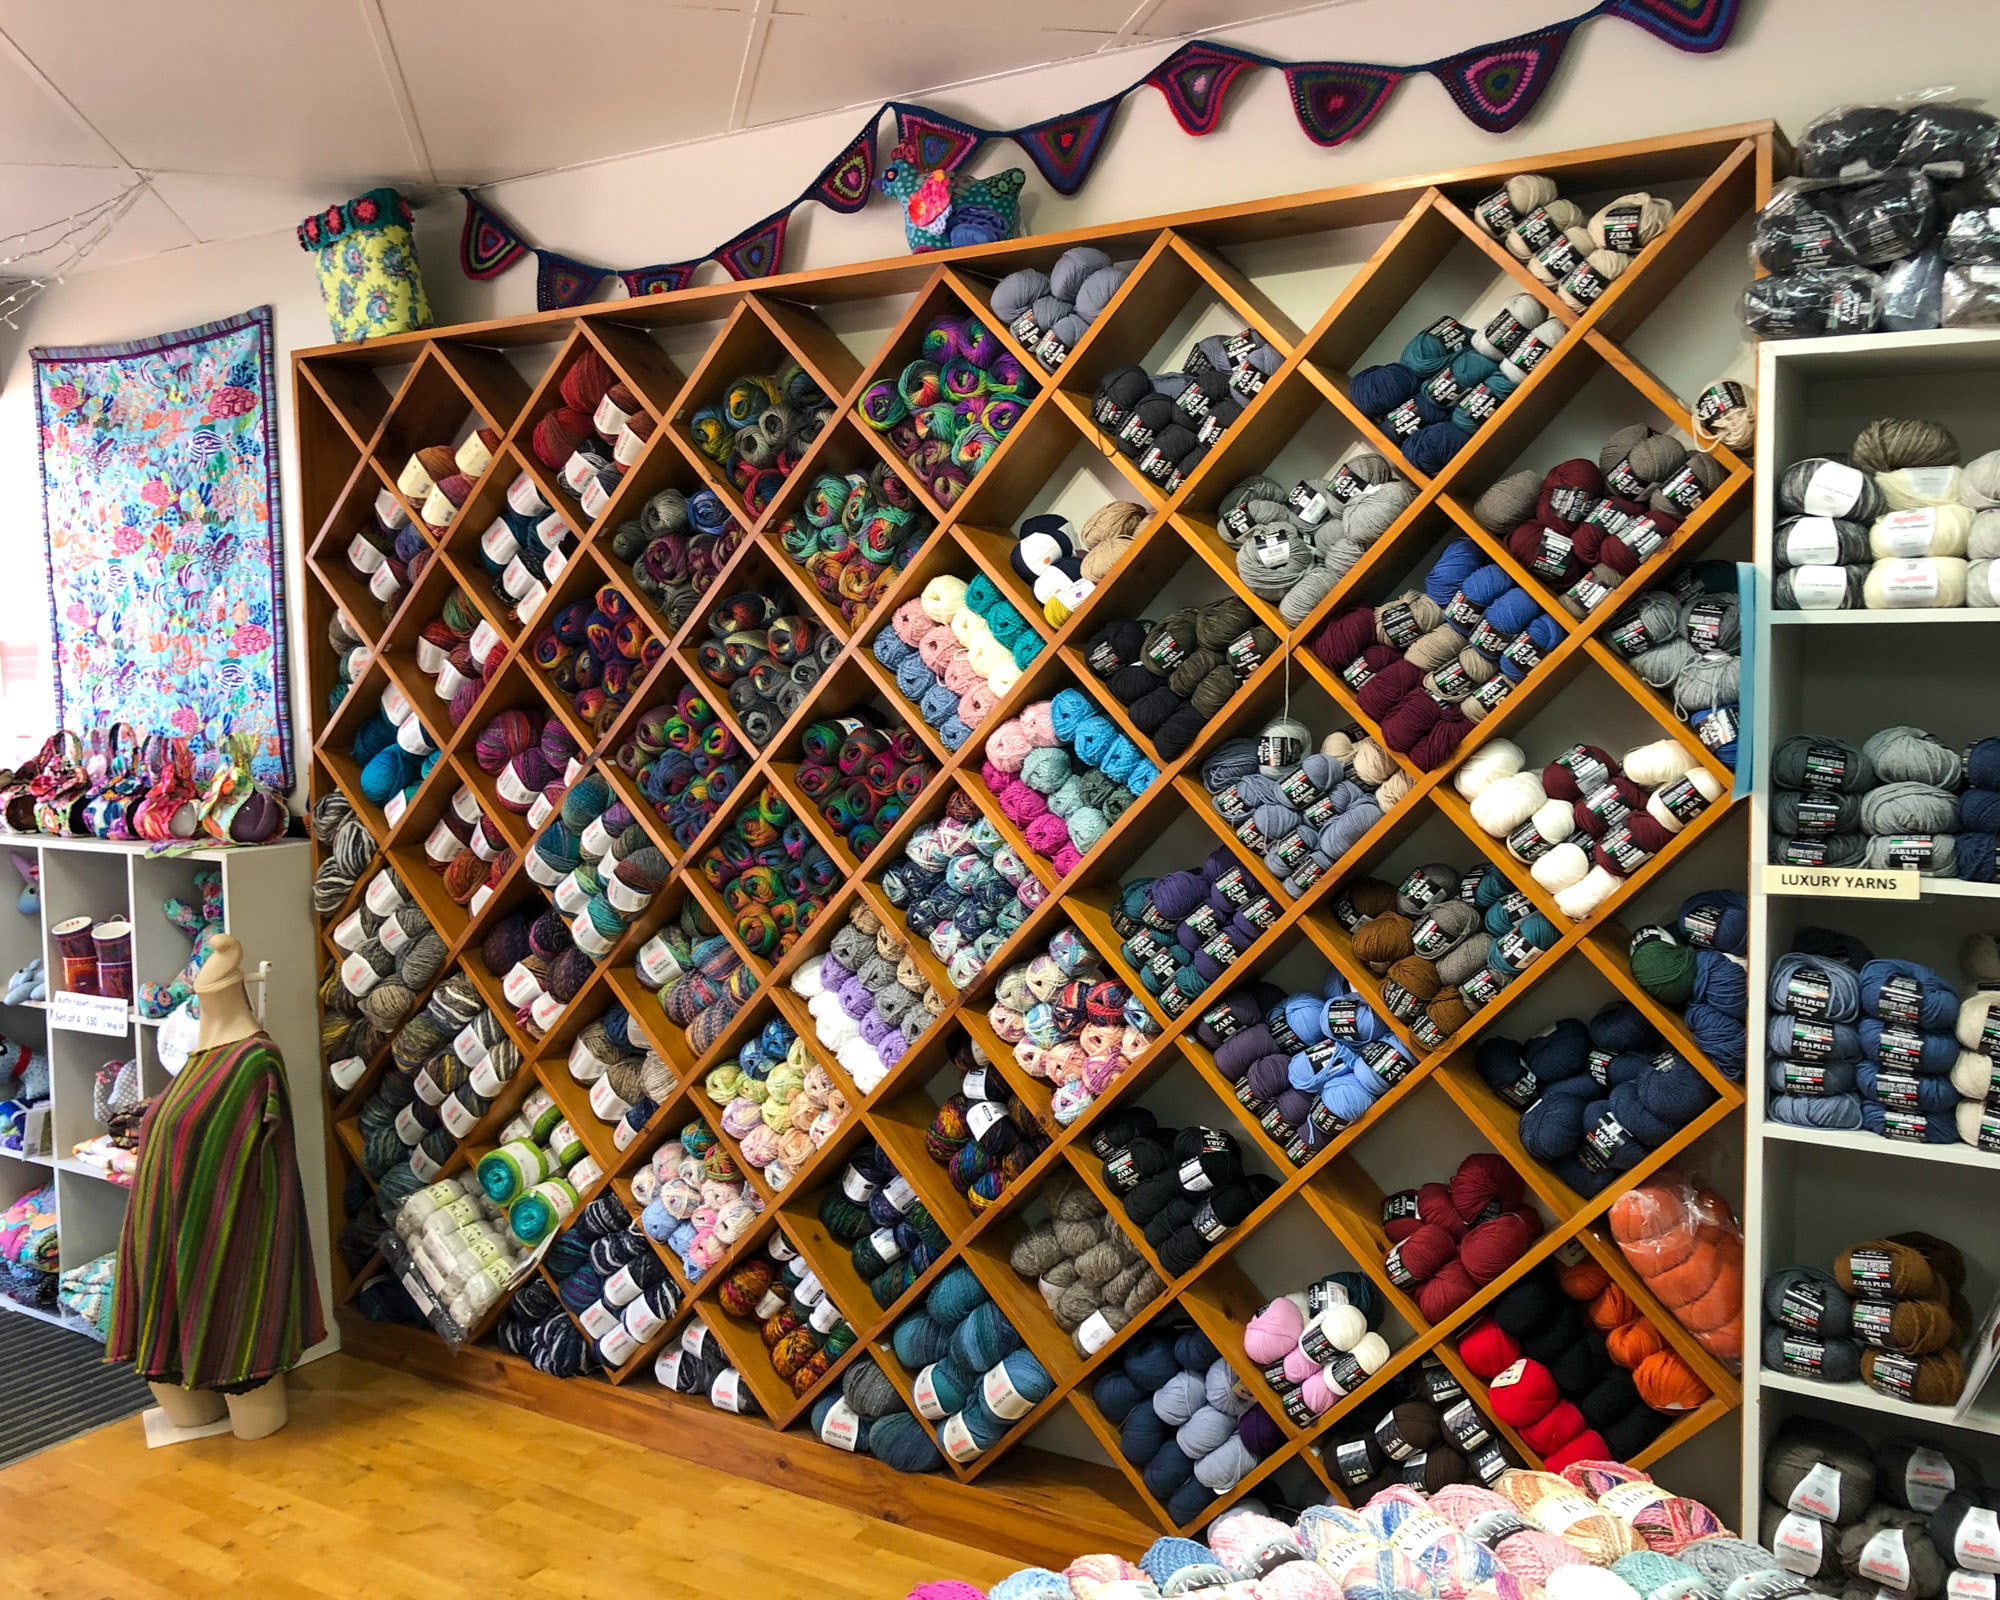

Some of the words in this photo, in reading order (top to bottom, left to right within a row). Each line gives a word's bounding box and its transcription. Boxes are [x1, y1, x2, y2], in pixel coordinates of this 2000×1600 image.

[1622, 635, 1646, 648] ZARA
[1693, 631, 1712, 639] ZARA
[1513, 644, 1532, 661] ZARA
[1353, 671, 1371, 686] ZARA
[1444, 675, 1465, 690] ZARA
[1482, 681, 1501, 699] ZARA
[1805, 773, 1823, 781] ZARA
[1824, 775, 1842, 783] PLUS
[1291, 784, 1309, 798] ZARA
[1676, 797, 1701, 817] ZARA
[1524, 843, 1548, 861] ZARA
[1782, 874, 1840, 887] LUXURY
[1846, 877, 1897, 889] YARNS
[1226, 883, 1245, 897] ZARA
[1197, 917, 1214, 933] ZARA
[1255, 911, 1273, 925] ZARA
[1425, 933, 1441, 950] ZARA
[1215, 943, 1232, 958] ZARA
[1475, 984, 1493, 1000] ZARA
[1788, 995, 1807, 1004] ZARA
[1807, 999, 1826, 1008] PLUS
[54, 1012, 66, 1022] Set
[68, 1014, 75, 1022] of
[1214, 1015, 1235, 1032] ZARA
[1333, 1025, 1355, 1034] ZARA
[1793, 1040, 1813, 1049] ZARA
[1814, 1043, 1831, 1051] PLUS
[1880, 1051, 1899, 1060] ZARA
[1901, 1055, 1919, 1063] PLUS
[1386, 1060, 1406, 1081] ZARA
[1273, 1122, 1290, 1137] ZARA
[1322, 1115, 1336, 1131] ZARA
[1885, 1127, 1904, 1135] ZARA
[1906, 1130, 1925, 1138] PLUS
[1116, 1167, 1134, 1179] ZARA
[1199, 1218, 1216, 1233] ZARA
[1854, 1322, 1873, 1331] ZARA
[1874, 1324, 1890, 1333] PLUS
[1315, 1346, 1335, 1362] ZARA
[1784, 1361, 1803, 1369] ZARA
[1804, 1366, 1821, 1374] PLUS
[1346, 1375, 1368, 1389] ZARA
[1432, 1380, 1456, 1391] ZARA
[1288, 1402, 1307, 1416] ZARA
[1458, 1423, 1480, 1441] ZARA
[1385, 1438, 1403, 1453] ZARA
[1478, 1449, 1497, 1467] ZARA
[1349, 1467, 1367, 1477] ZARA
